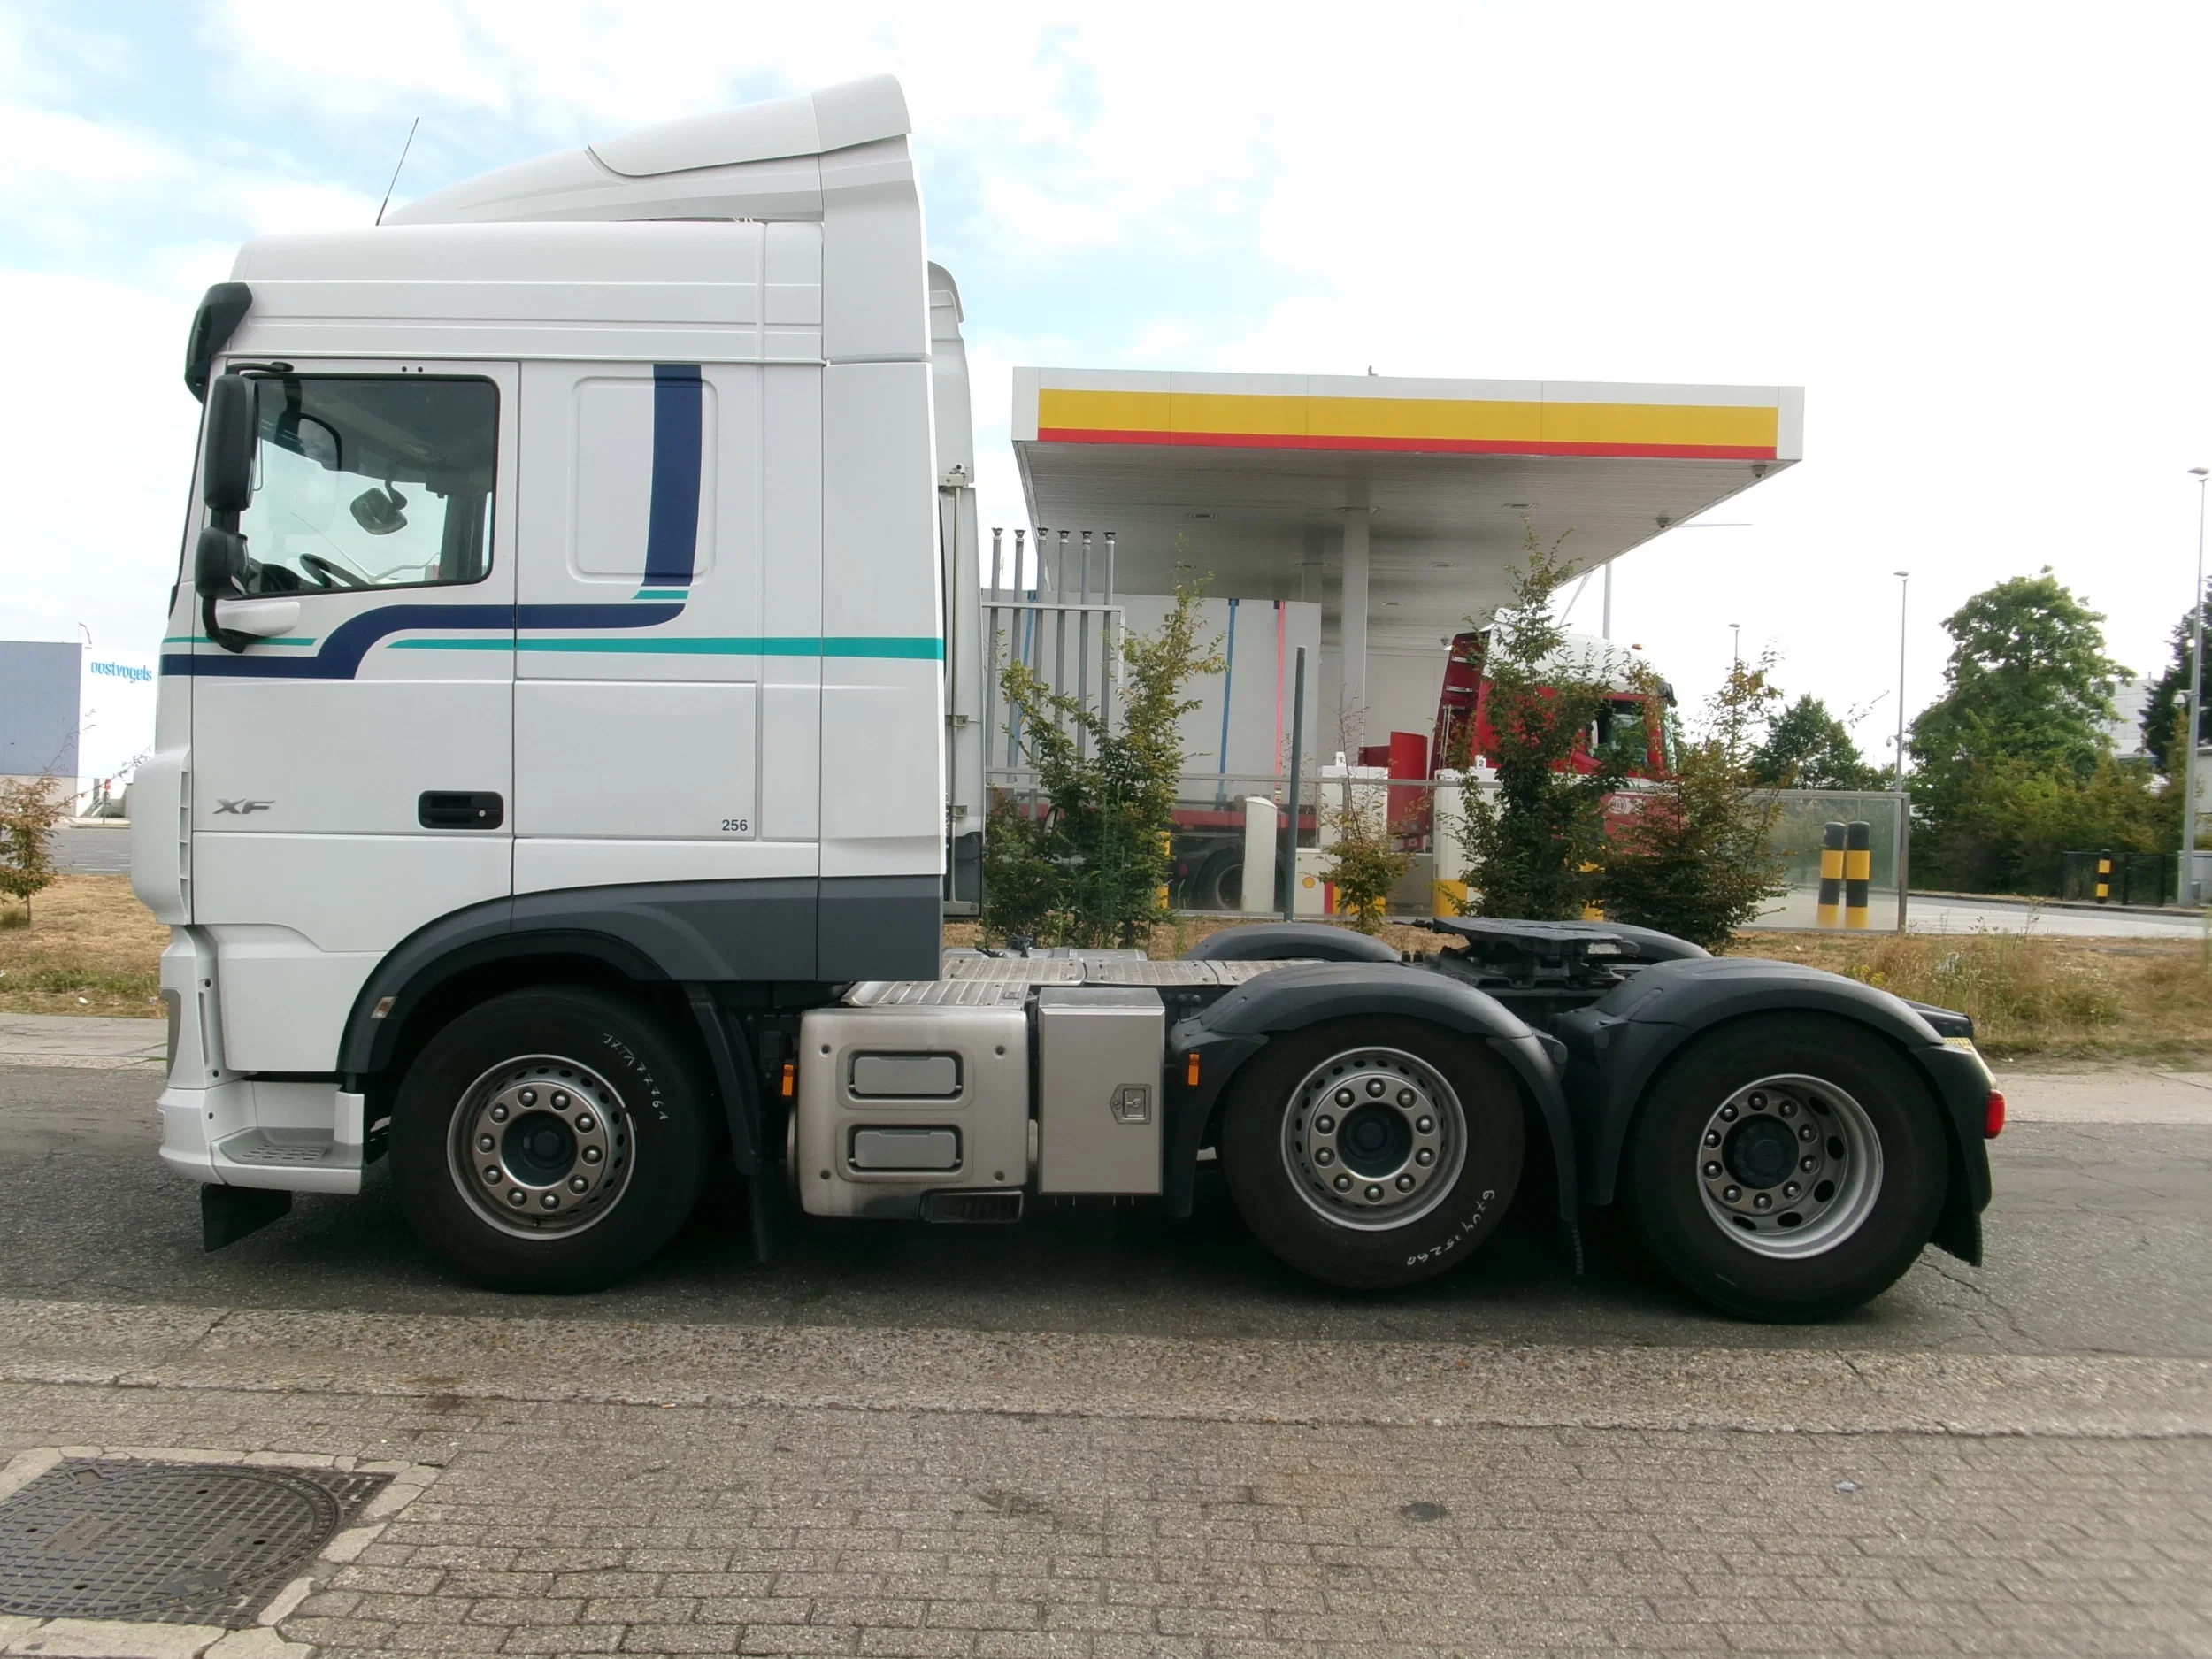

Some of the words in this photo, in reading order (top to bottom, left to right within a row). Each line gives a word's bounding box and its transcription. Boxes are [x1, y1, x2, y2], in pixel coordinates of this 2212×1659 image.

[91, 661, 152, 683] oostvogels
[212, 798, 276, 815] XF
[721, 818, 748, 832] 256
